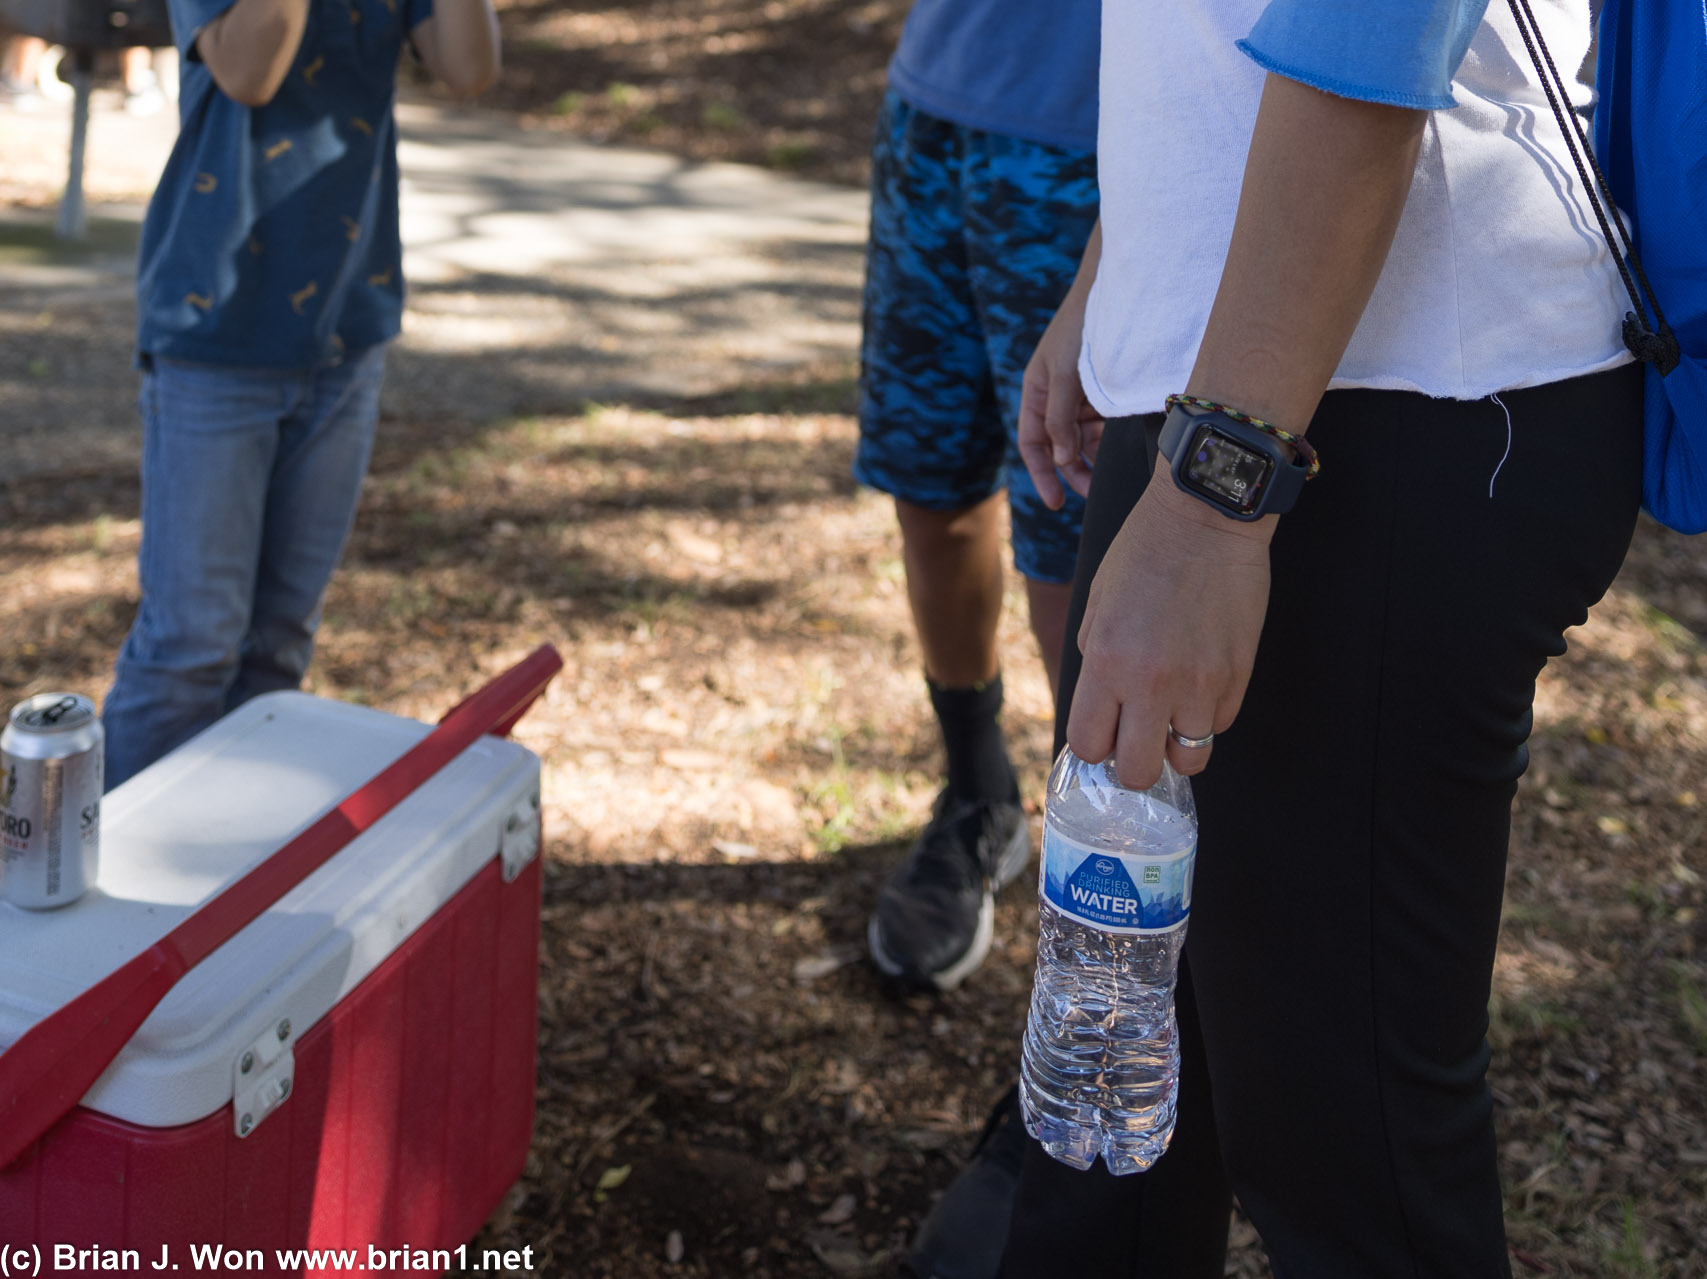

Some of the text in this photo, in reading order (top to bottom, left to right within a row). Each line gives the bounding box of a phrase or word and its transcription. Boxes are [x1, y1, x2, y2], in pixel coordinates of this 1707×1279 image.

[1228, 478, 1247, 503] 3:11
[1078, 878, 1131, 898] DRINKING
[1080, 871, 1130, 890] PURIFIED
[1070, 883, 1138, 915] WATER
